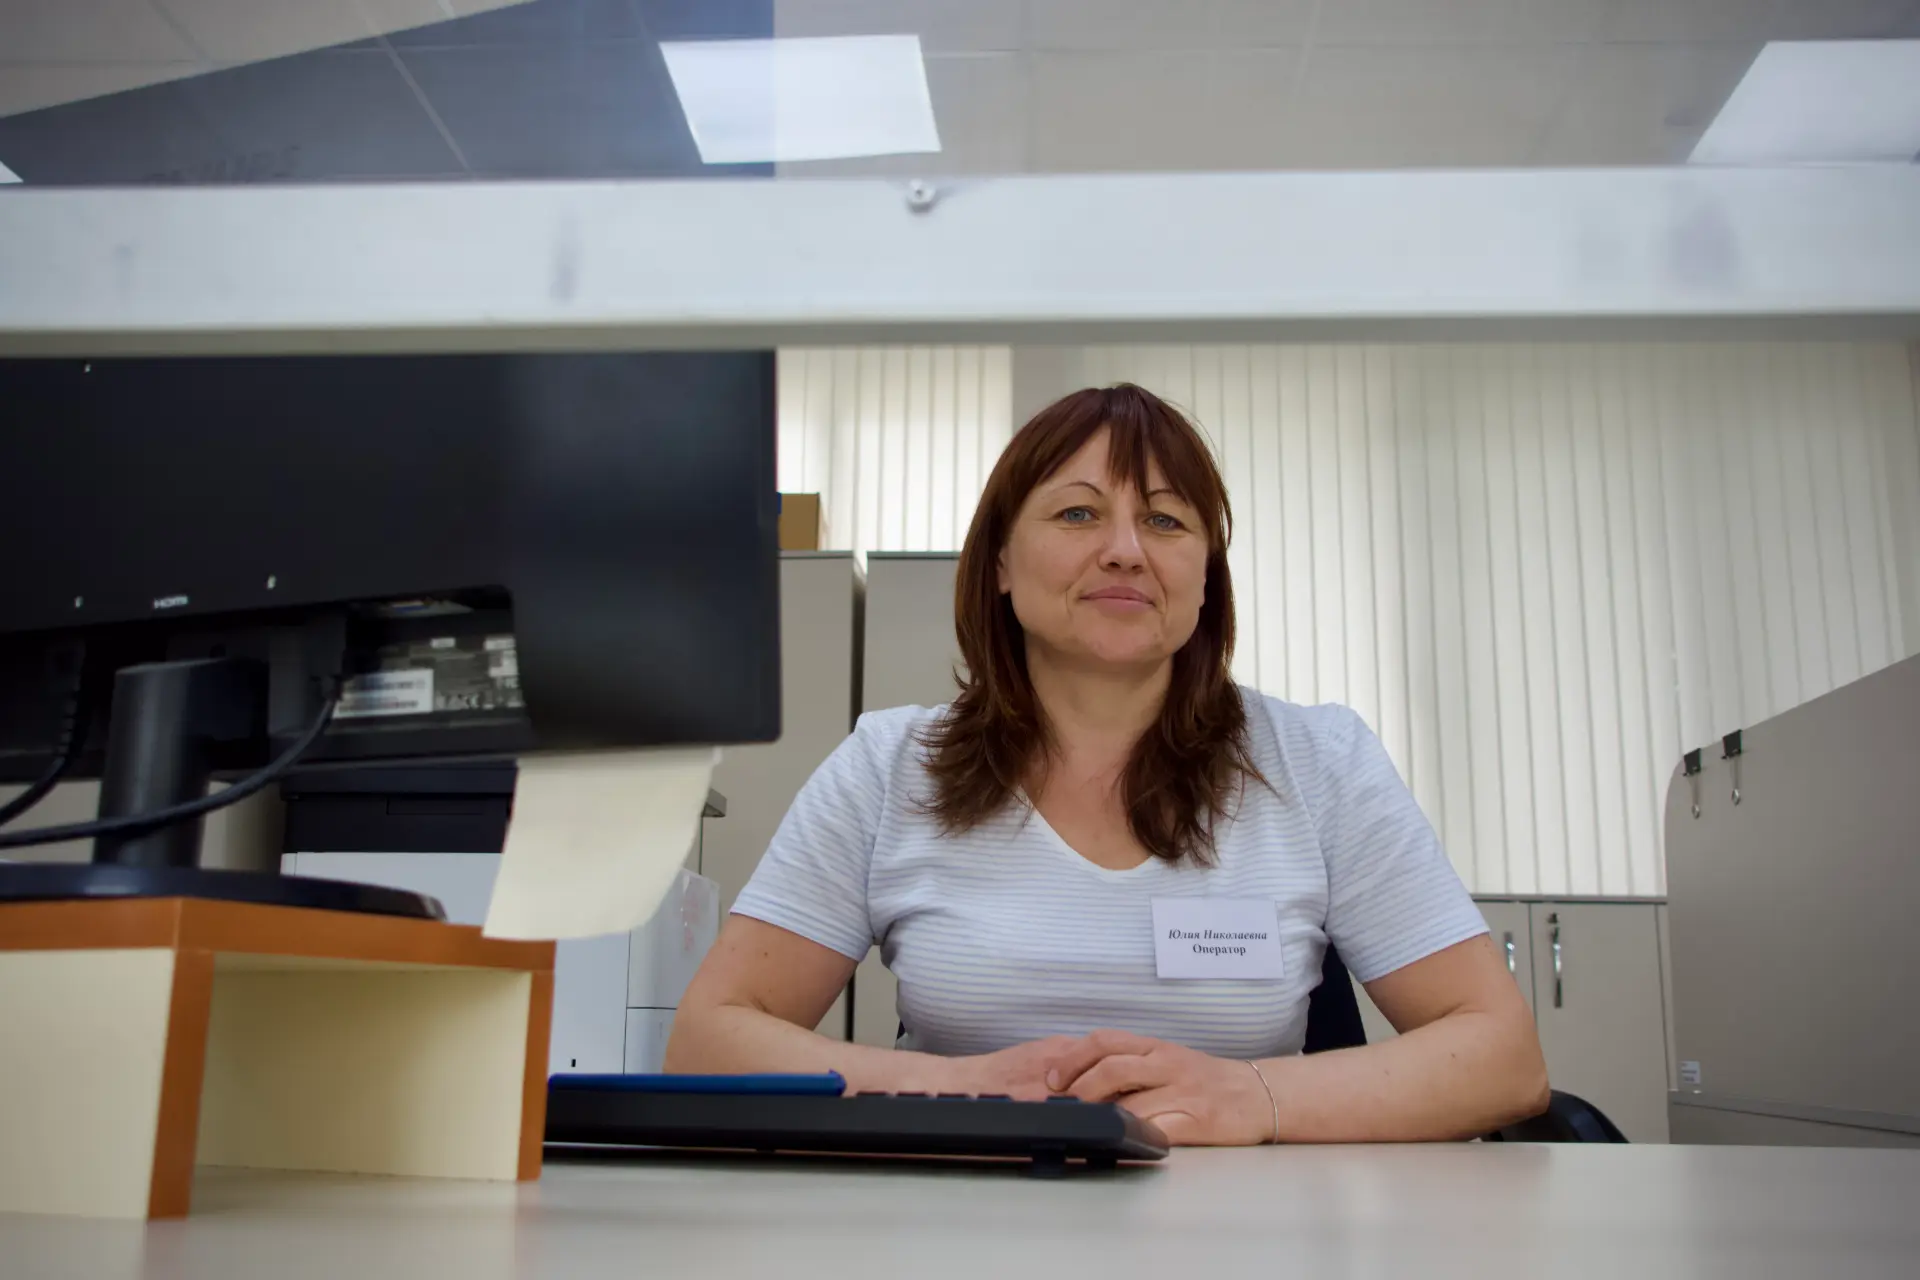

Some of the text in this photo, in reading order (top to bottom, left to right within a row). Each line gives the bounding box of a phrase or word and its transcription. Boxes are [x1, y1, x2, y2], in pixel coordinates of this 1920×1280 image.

[1168, 929, 1268, 940] Юлия Николаевна
[1192, 943, 1247, 956] Оператор
